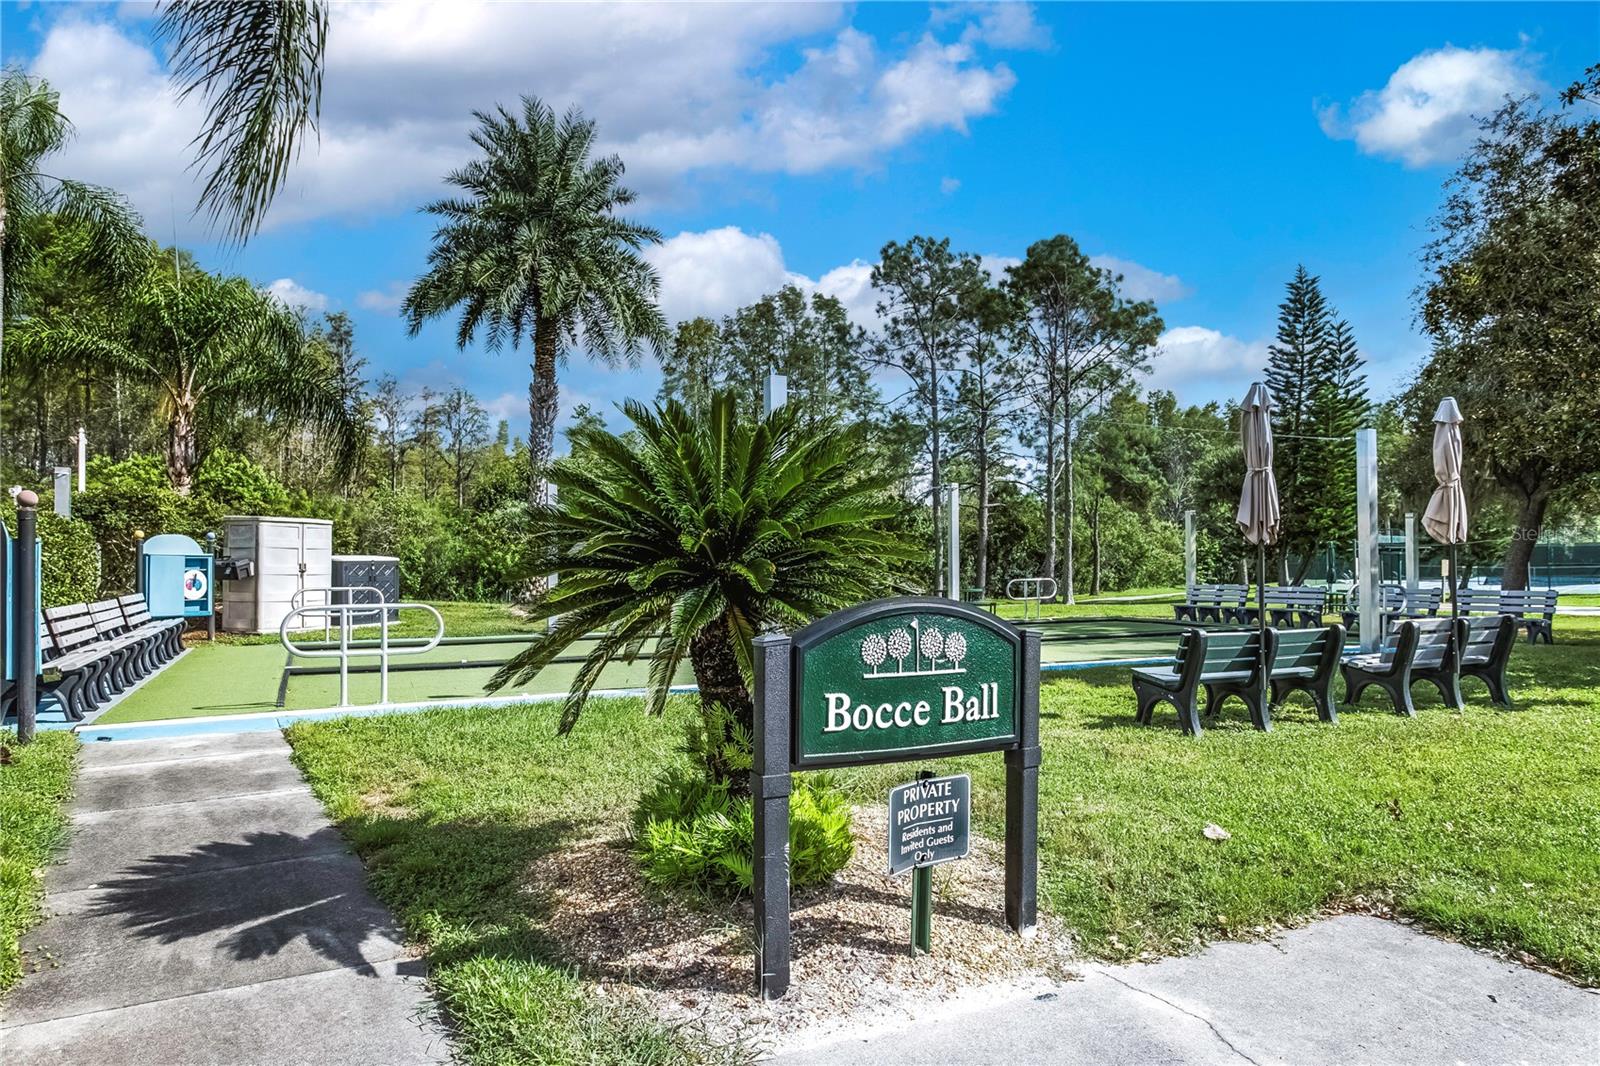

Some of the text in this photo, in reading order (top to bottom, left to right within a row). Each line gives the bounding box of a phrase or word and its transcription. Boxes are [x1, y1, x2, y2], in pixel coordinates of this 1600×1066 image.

[823, 682, 1000, 732] Bocce Ball
[903, 781, 952, 804] PRIVATE
[897, 798, 960, 826] PROPERTY
[902, 821, 953, 842] Residents and
[901, 834, 954, 855] Invited Guests
